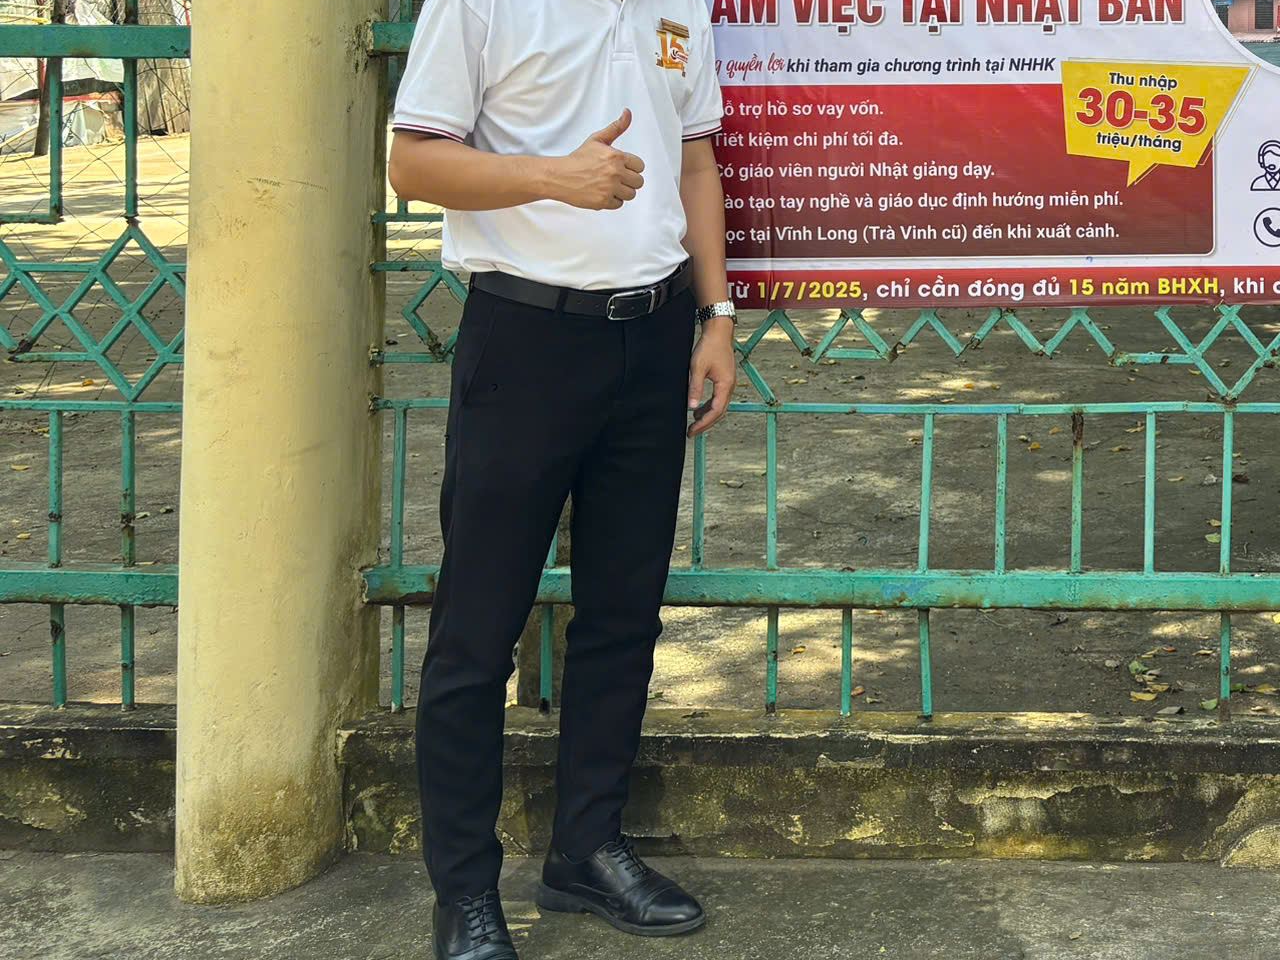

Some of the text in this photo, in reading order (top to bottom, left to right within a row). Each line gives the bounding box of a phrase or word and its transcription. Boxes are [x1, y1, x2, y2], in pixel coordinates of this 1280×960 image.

[726, 54, 763, 81] quyền
[767, 52, 785, 74] lợi
[787, 58, 809, 73] khi
[814, 58, 853, 72] tham
[857, 59, 880, 75] gia
[884, 58, 941, 75] chương
[946, 56, 981, 72] trình
[985, 57, 1005, 75] tại
[1009, 57, 1056, 72] NHHK
[1109, 72, 1178, 90] Thu nhập
[724, 100, 884, 118] ỗ trợ hồ sơ vay vốn.
[1076, 86, 1206, 135] 30-35
[715, 130, 903, 149] Tiết kiệm chi phí tối đa.
[1096, 132, 1182, 152] triệu/tháng
[739, 163, 774, 181] giáo
[779, 162, 813, 177] viên
[818, 162, 865, 180] người
[869, 162, 908, 180] Nhật
[913, 161, 957, 180] giảng
[962, 162, 995, 180] dạy.
[725, 190, 1123, 212] ào tạo tay nghề và giáo dục định hướng miễn phí.
[725, 221, 1119, 244] ọc tại Vĩnh Long (Trà Vinh cũ) đến khi xuất cảnh.
[758, 281, 868, 301] 1/7/2025,
[876, 279, 910, 298] chỉ
[919, 276, 959, 298] cần
[967, 278, 1025, 302] đóng
[1033, 277, 1061, 298] đủ
[1070, 279, 1094, 295] 15
[1102, 278, 1149, 295] năm
[1158, 277, 1226, 299] BHXH,
[1233, 276, 1264, 294] khi
